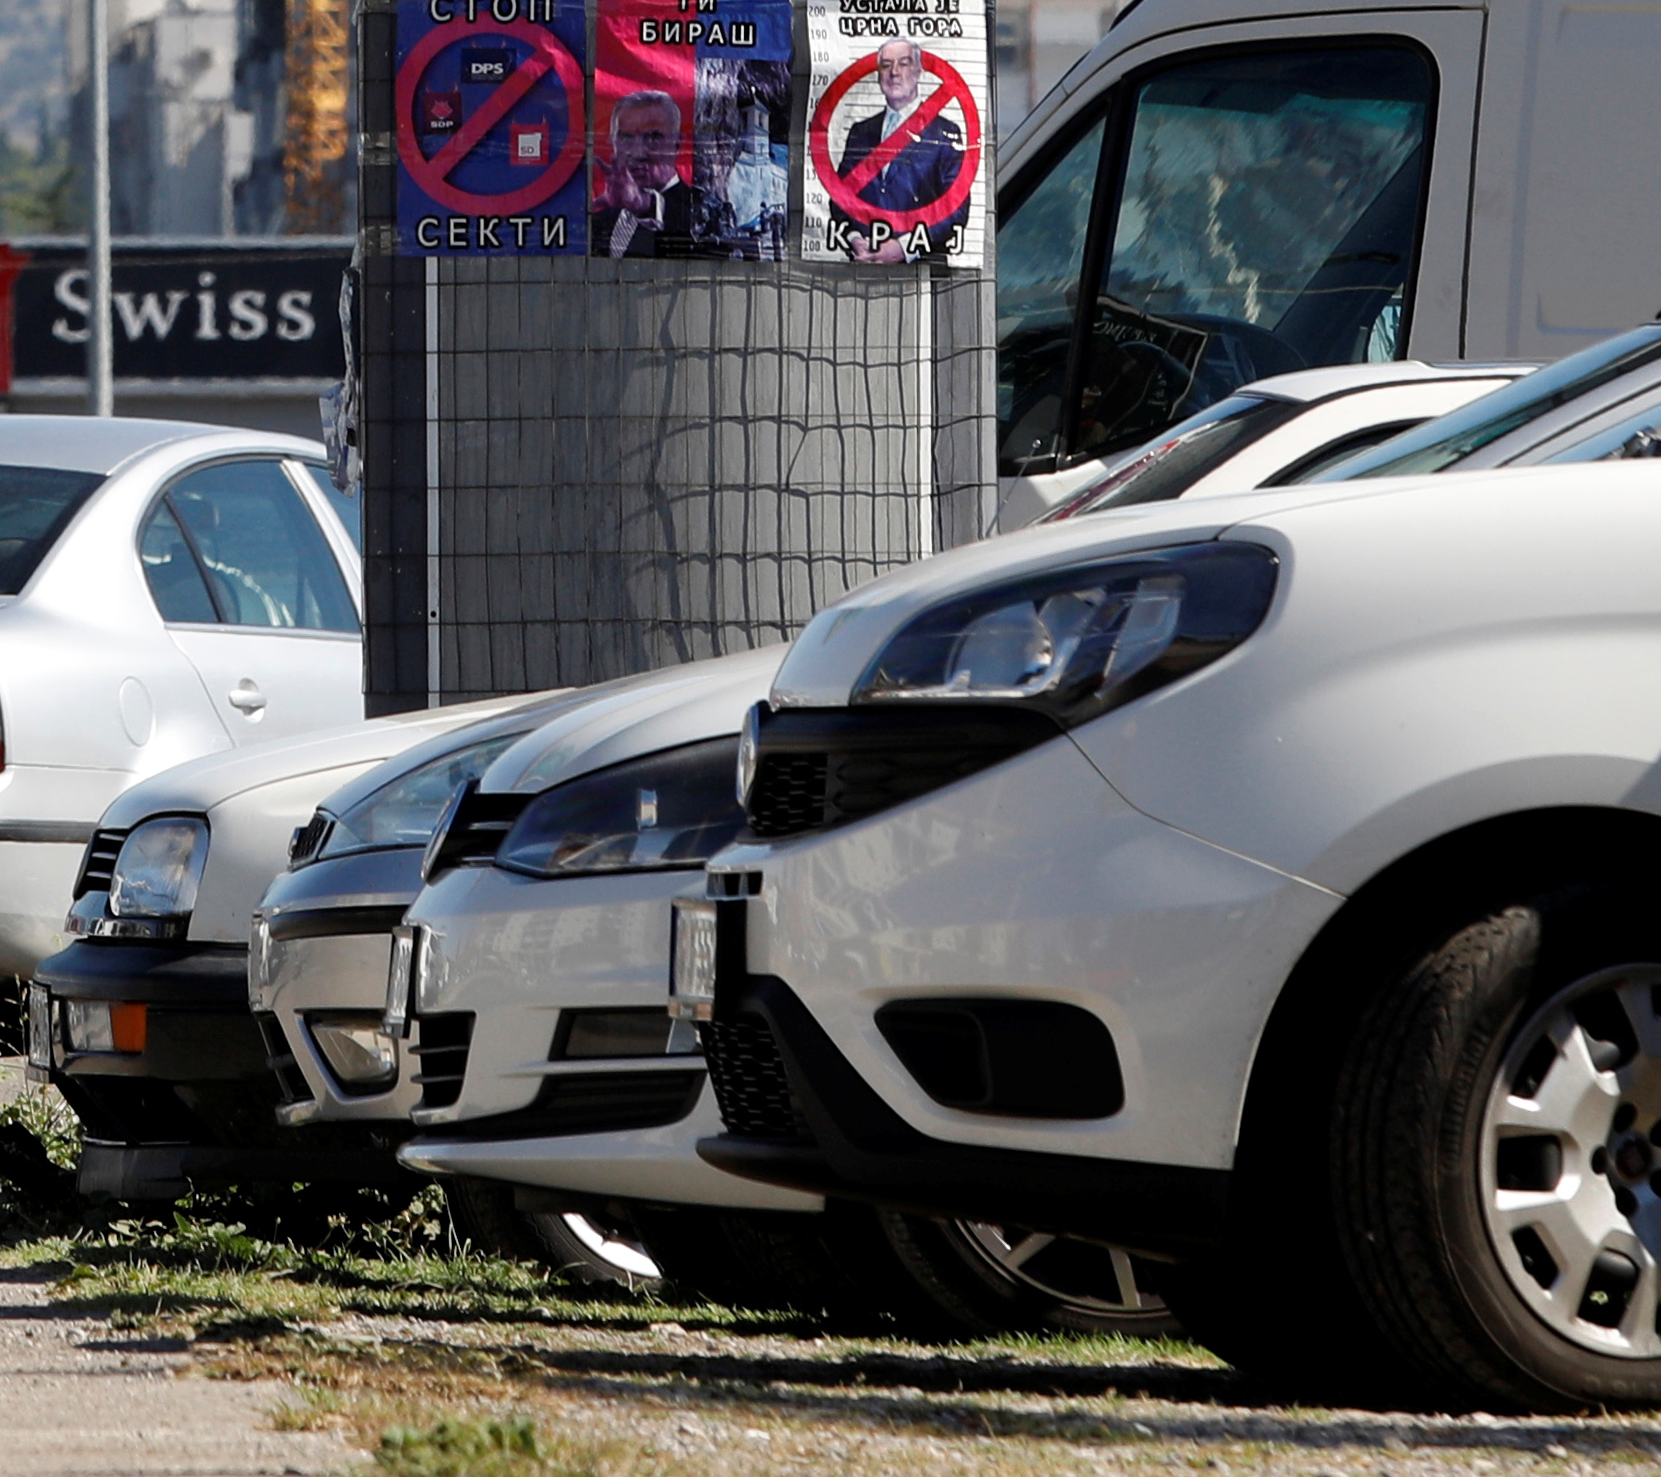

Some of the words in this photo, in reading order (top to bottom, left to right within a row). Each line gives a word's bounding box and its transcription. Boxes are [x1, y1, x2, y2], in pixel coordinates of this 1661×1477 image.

[641, 21, 754, 45] БИРАШ
[841, 18, 898, 35] ЦРНА
[909, 18, 962, 35] ГОРА
[471, 63, 504, 74] DPS
[417, 217, 565, 247] СЕКТИ
[829, 219, 964, 254] КРАЈ
[53, 270, 316, 342] Swiss
